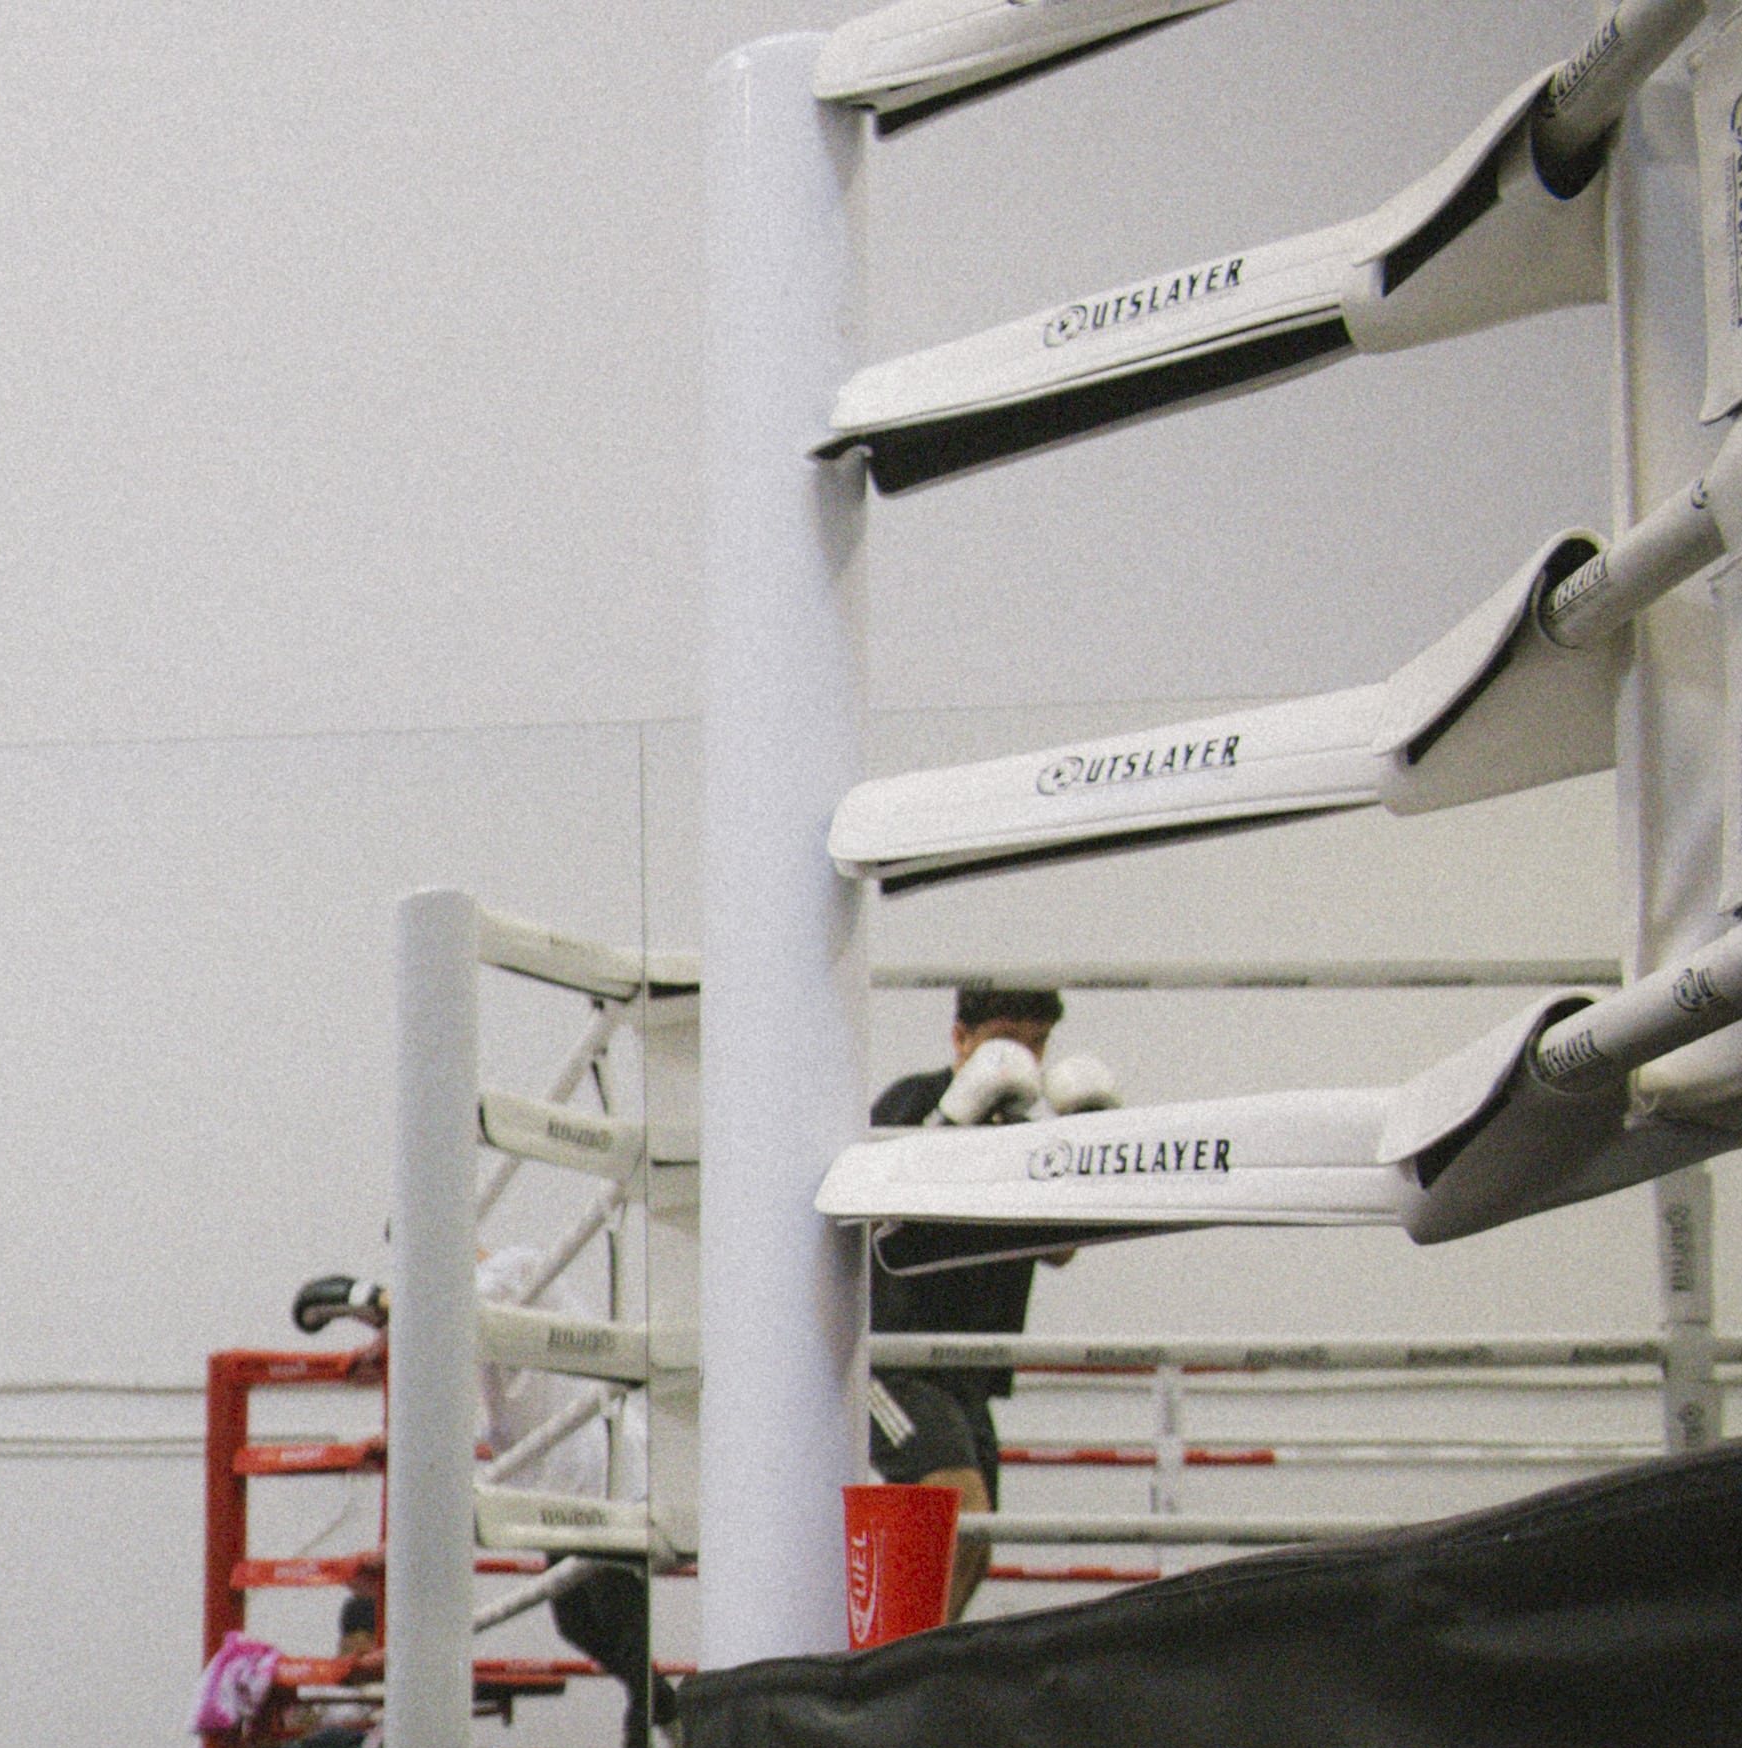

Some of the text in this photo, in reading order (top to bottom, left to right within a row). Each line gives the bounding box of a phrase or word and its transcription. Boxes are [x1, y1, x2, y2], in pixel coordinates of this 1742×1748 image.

[1043, 258, 1244, 348] OUTSLAYER
[1036, 735, 1240, 796] OUTSLAYER
[1027, 1138, 1231, 1181] OUTSLAYER
